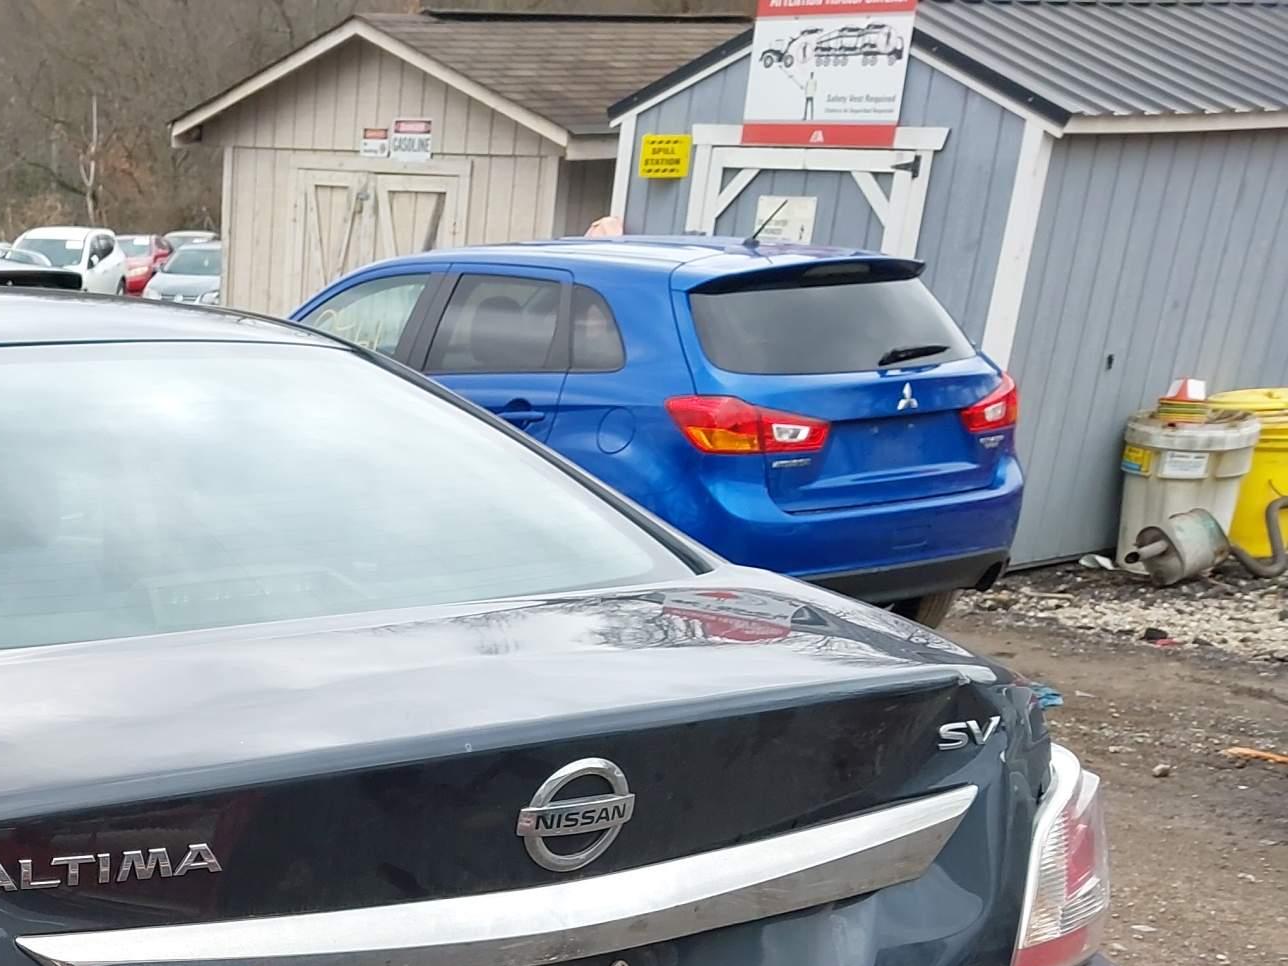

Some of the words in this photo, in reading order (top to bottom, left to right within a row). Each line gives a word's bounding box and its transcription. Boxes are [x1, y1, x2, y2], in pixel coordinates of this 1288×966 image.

[393, 136, 431, 152] GASOLINE
[652, 147, 676, 155] SPILL
[644, 157, 681, 166] STATION
[938, 715, 1001, 750] SV
[535, 803, 626, 830] NISSAN
